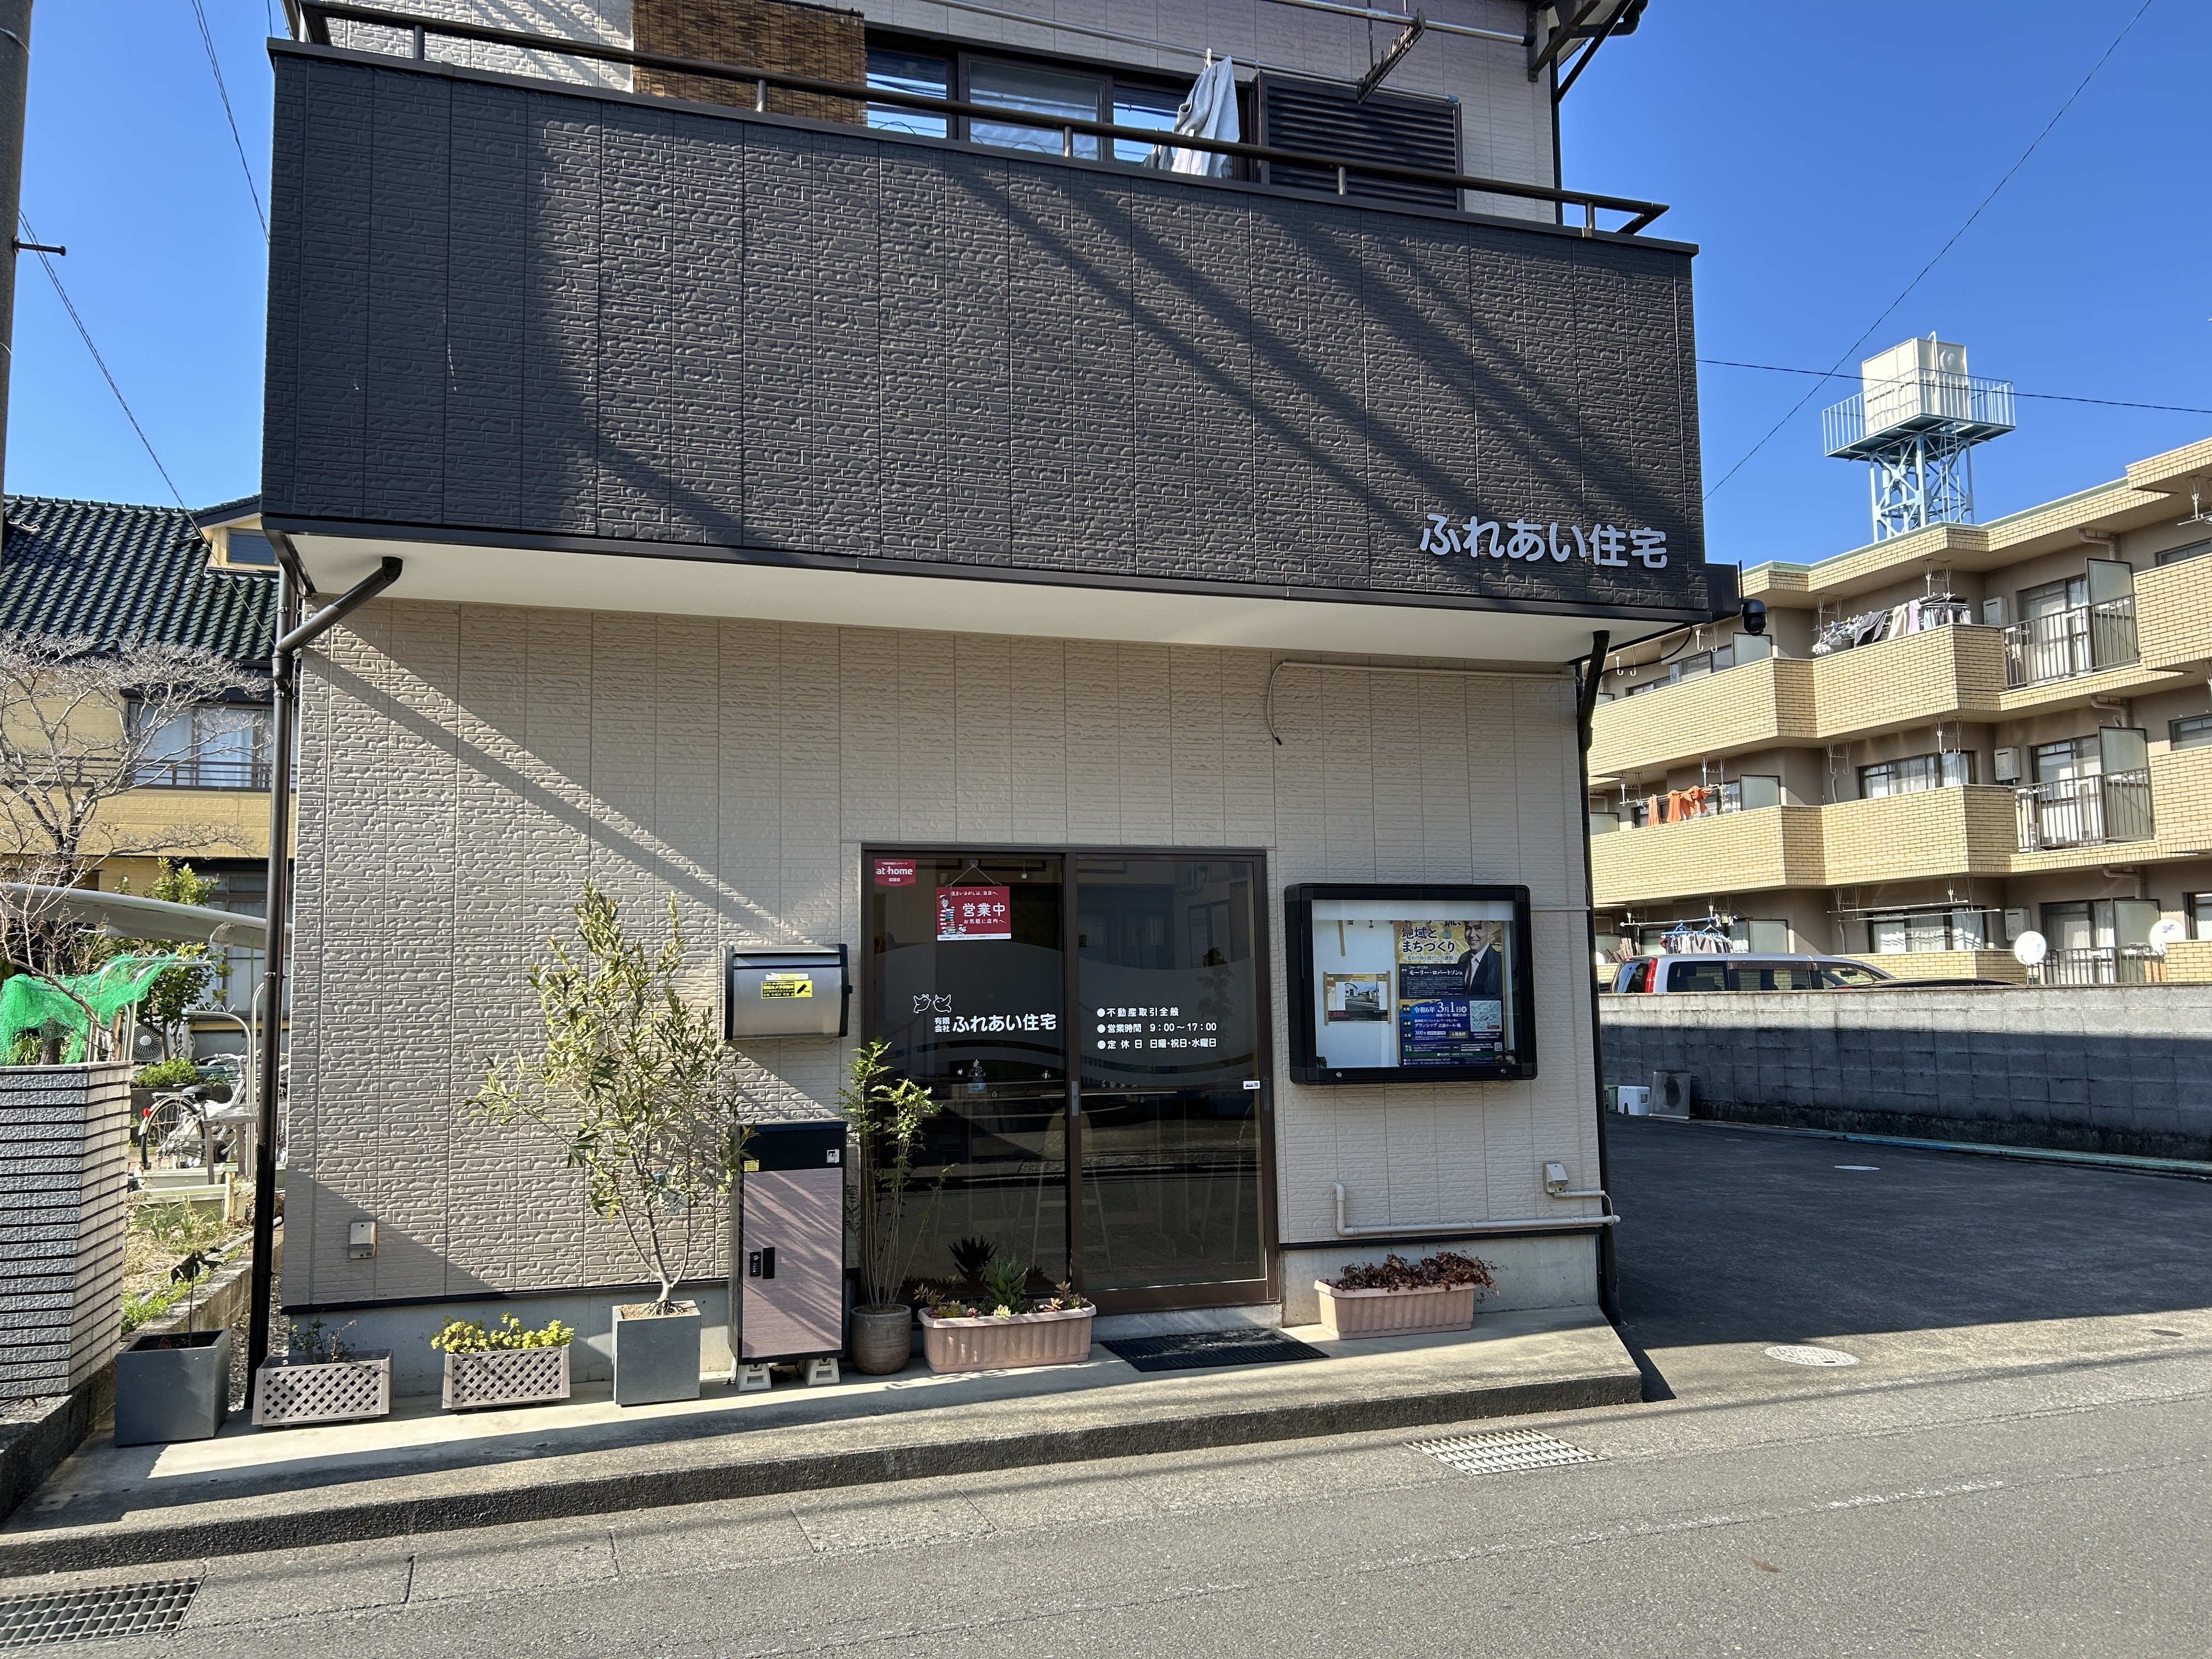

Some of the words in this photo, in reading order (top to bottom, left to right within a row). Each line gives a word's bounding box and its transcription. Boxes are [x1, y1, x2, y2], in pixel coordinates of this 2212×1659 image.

[1420, 514, 1667, 568] ふれあい住宅
[887, 866, 913, 874] home
[962, 902, 1006, 917] 営業中
[1402, 940, 1455, 952] まちづくり
[1107, 1007, 1179, 1017] 不動産取引全般
[952, 1013, 1056, 1032] ふれあい住宅
[1107, 1024, 1142, 1033] 営業時間
